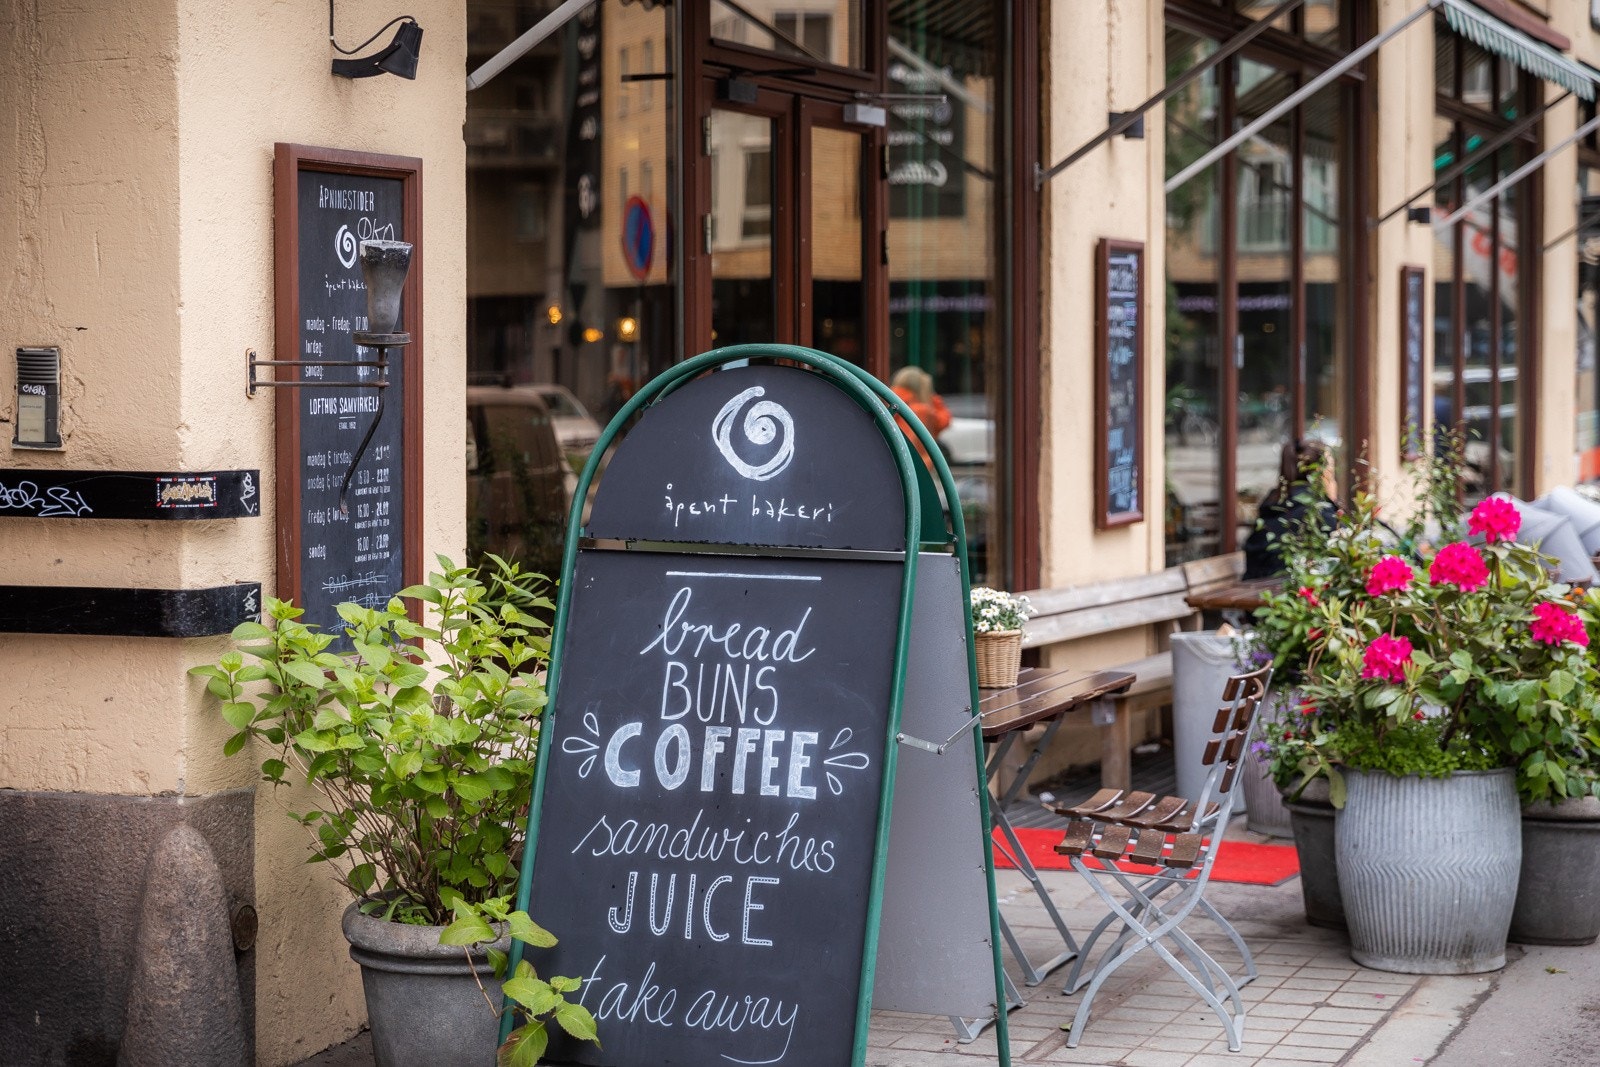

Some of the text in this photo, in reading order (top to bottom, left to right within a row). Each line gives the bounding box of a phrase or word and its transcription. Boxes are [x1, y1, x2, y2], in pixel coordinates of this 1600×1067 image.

[319, 184, 375, 212] ÅPNINGSTIDER
[309, 397, 338, 415] LOFTHUS
[664, 482, 832, 527] åpent bakeri
[639, 586, 817, 663] bread
[660, 661, 779, 726] BUNS
[603, 721, 819, 800] COFFEE
[571, 808, 836, 873] sandwiches
[608, 871, 780, 946] JUICE
[579, 954, 799, 1065] take away
